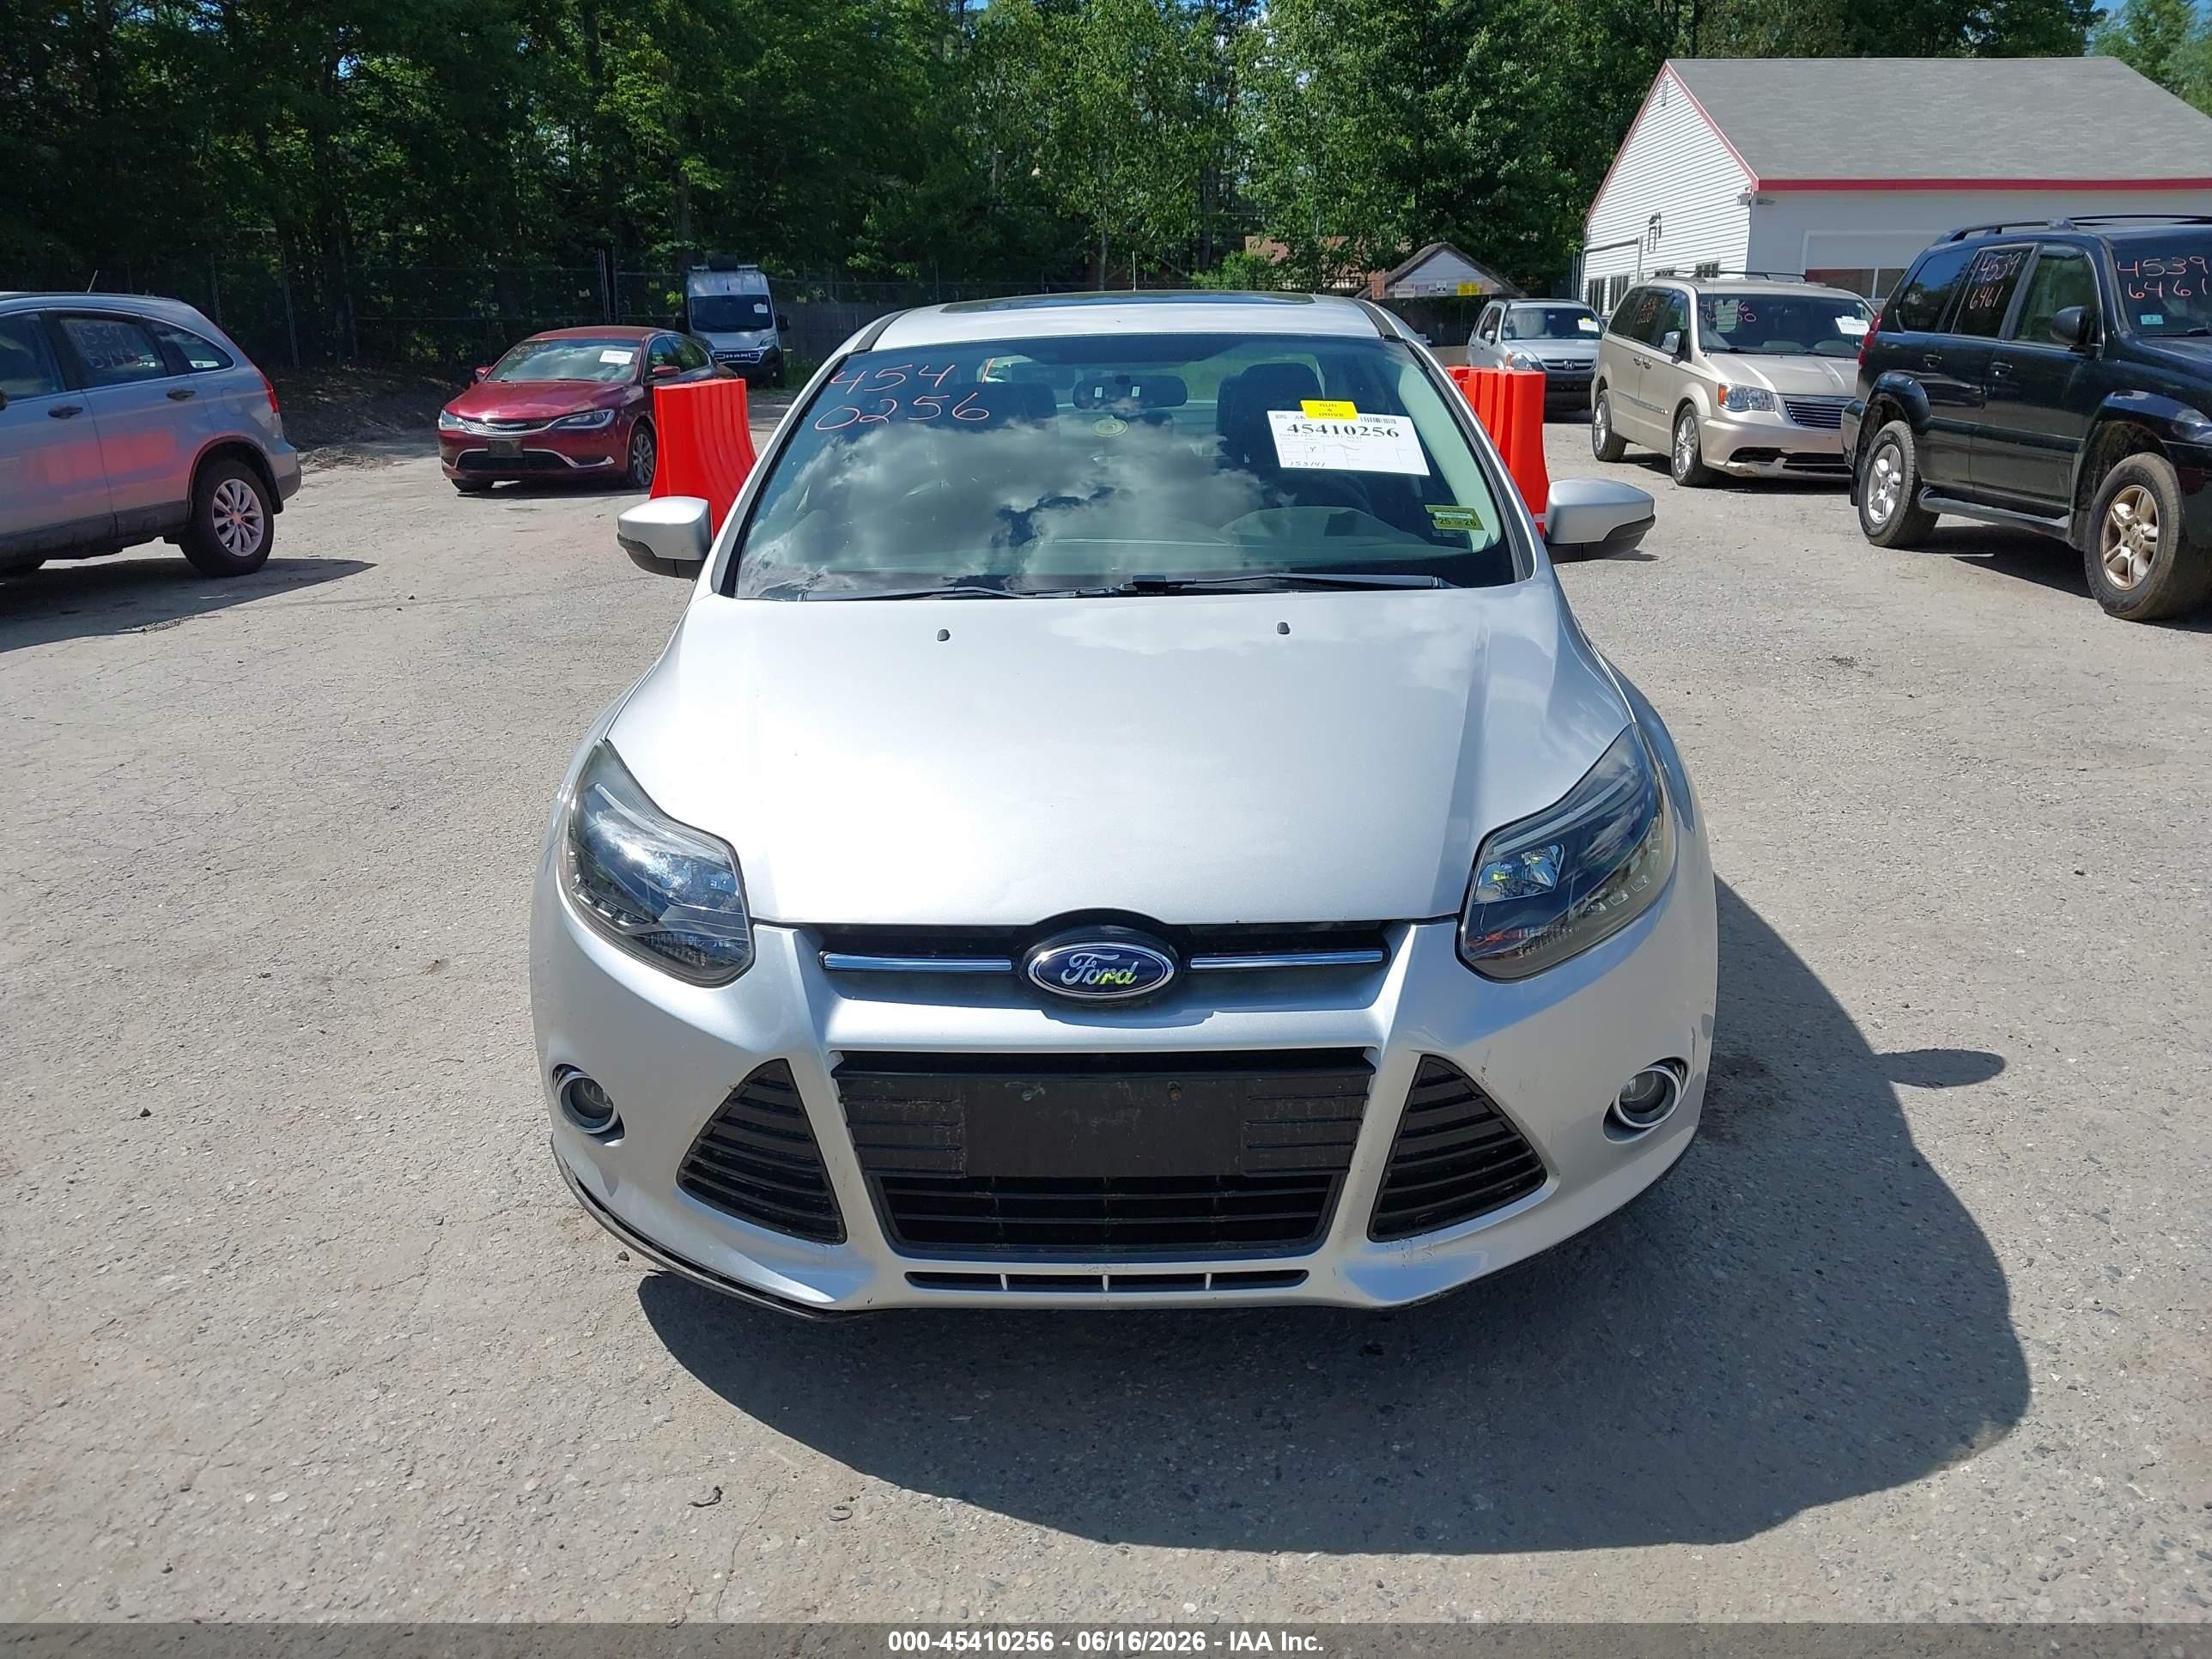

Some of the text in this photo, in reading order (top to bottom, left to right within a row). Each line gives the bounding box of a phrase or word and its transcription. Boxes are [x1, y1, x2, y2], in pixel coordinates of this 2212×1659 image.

[1981, 252, 2022, 283] 4539
[2117, 256, 2209, 277] 4539
[1969, 286, 2004, 309] 6461
[2129, 278, 2208, 299] 6461
[814, 392, 990, 430] 0256
[1286, 423, 1400, 438] 45410256
[1060, 952, 1139, 985] Ford
